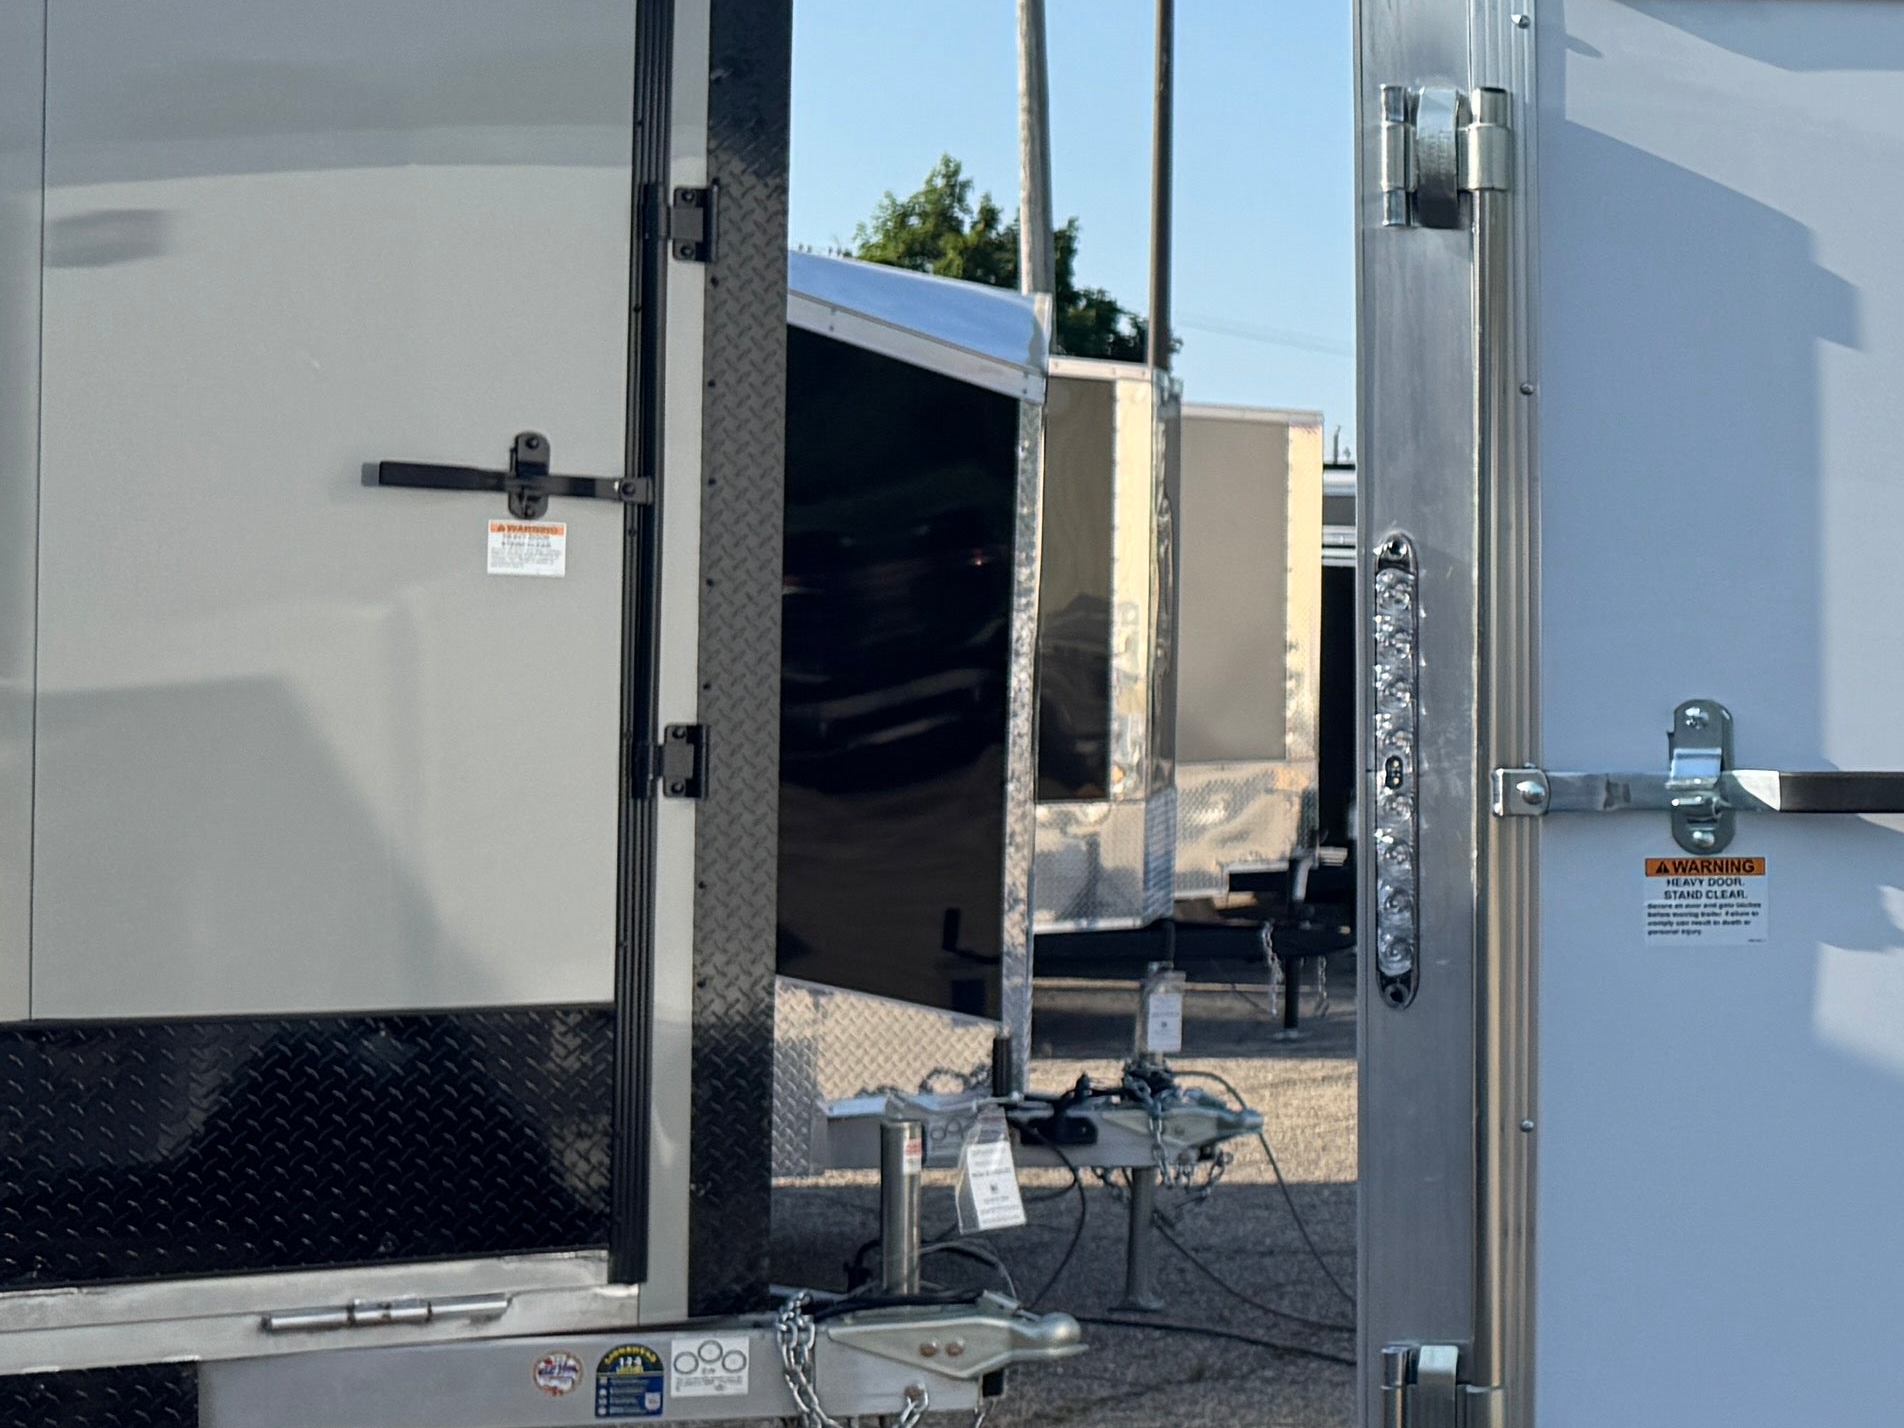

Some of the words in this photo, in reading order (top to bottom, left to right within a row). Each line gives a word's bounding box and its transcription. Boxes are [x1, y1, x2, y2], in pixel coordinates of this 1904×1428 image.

[1672, 858, 1755, 874] WARNING
[1666, 877, 1705, 887] HEAVY
[1664, 890, 1703, 900] STAND
